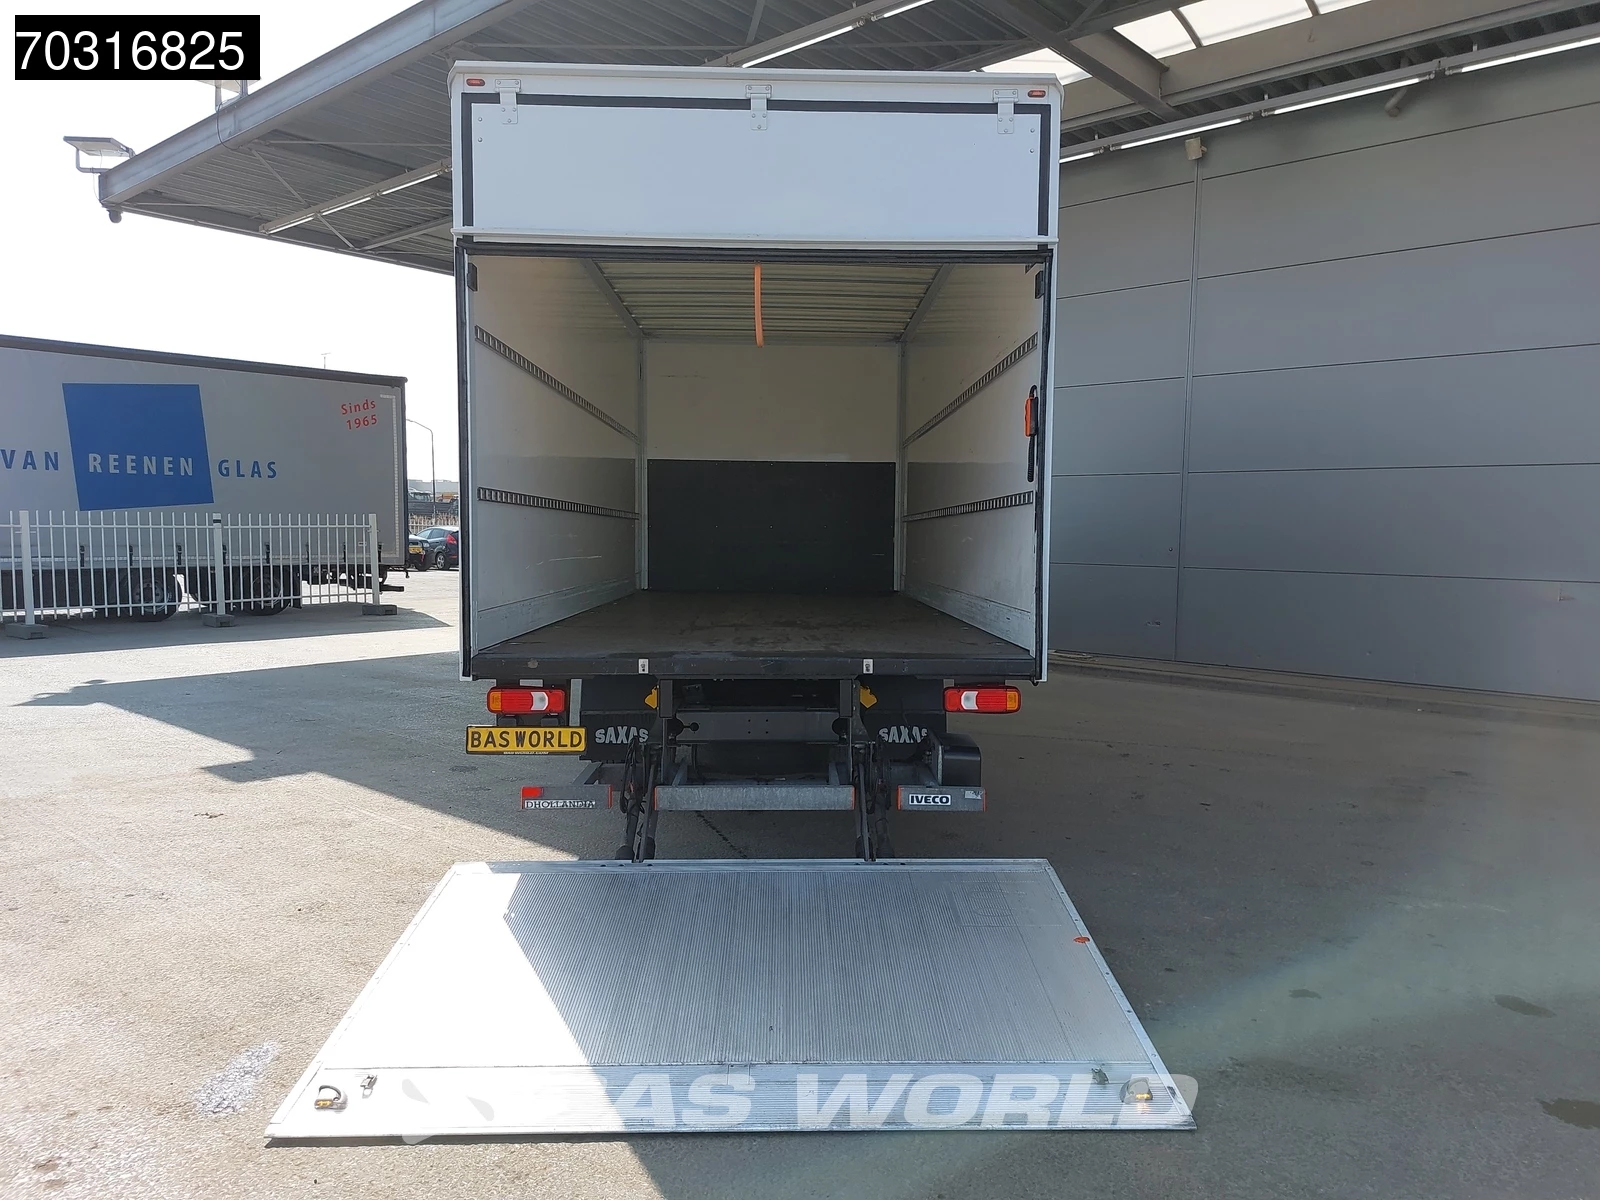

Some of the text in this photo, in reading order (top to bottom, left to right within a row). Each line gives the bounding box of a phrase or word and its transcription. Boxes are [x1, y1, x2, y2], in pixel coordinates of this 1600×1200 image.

[341, 399, 377, 415] Sinds
[346, 414, 378, 430] 1965
[0, 449, 277, 479] VAN REENEN GLAS
[470, 730, 583, 748] BAS WORLD
[910, 795, 950, 804] IVECO
